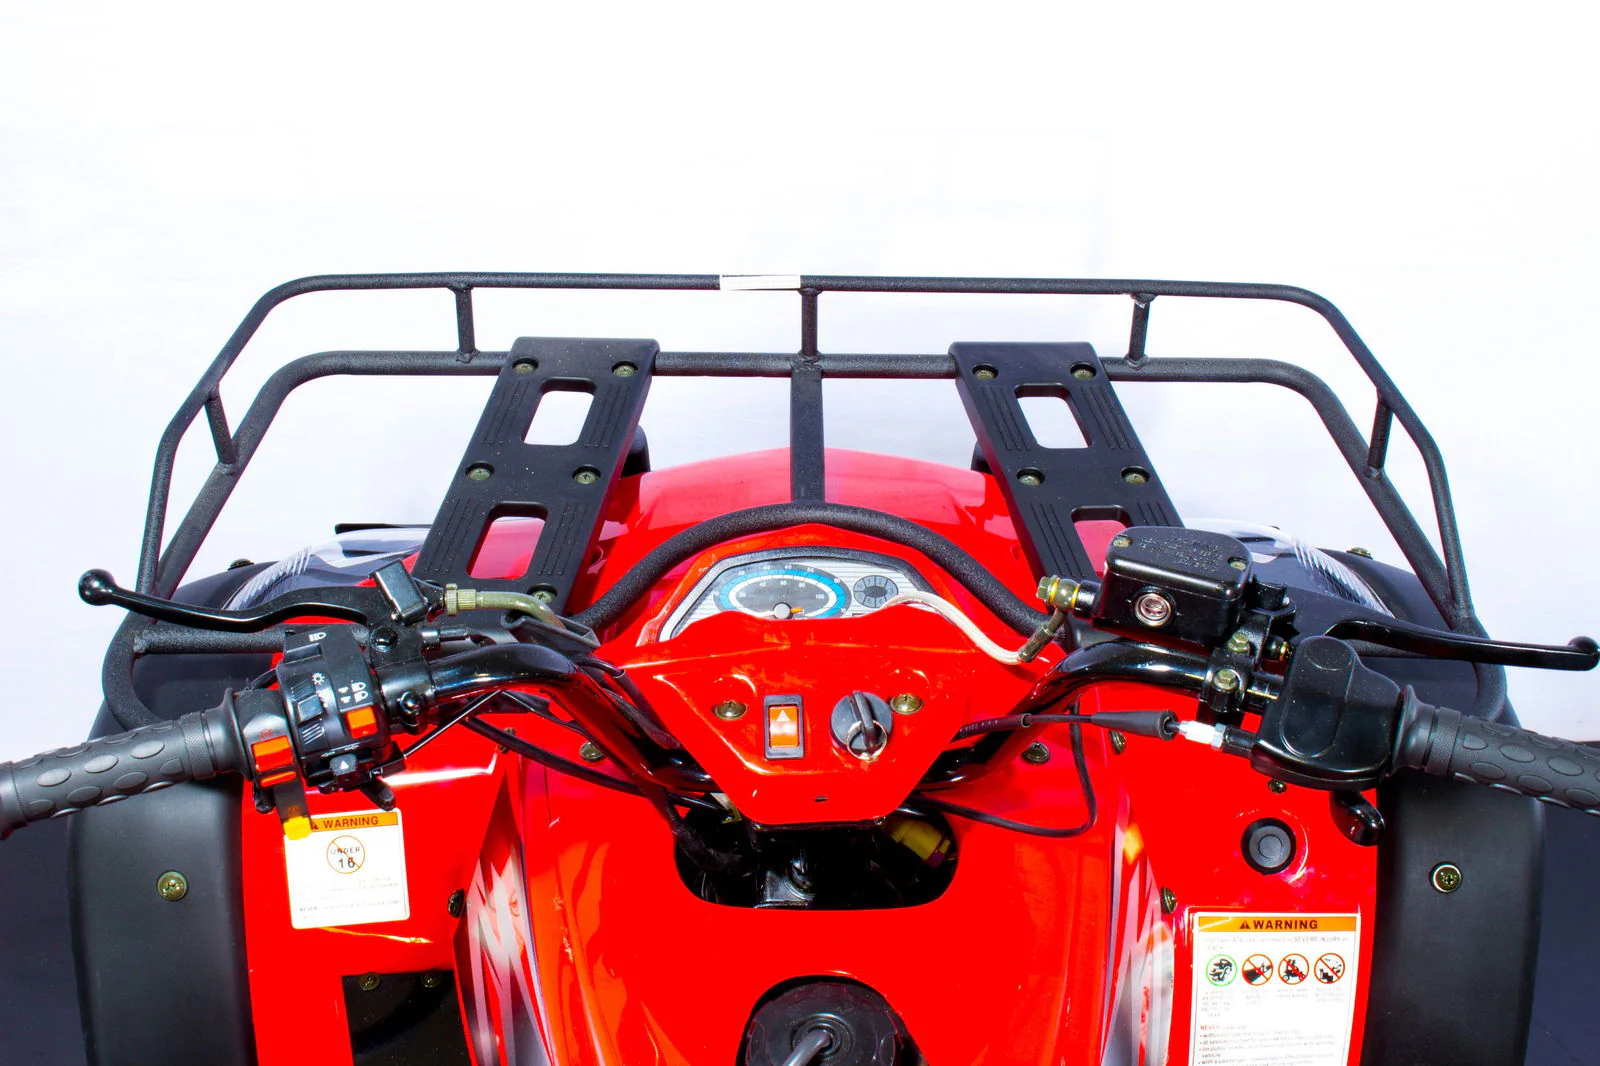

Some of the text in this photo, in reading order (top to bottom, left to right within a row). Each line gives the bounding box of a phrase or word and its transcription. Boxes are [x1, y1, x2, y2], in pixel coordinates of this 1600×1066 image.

[323, 816, 379, 829] WARNING
[330, 846, 360, 855] UNDER
[338, 858, 355, 869] 16
[1253, 919, 1318, 930] WARNING
